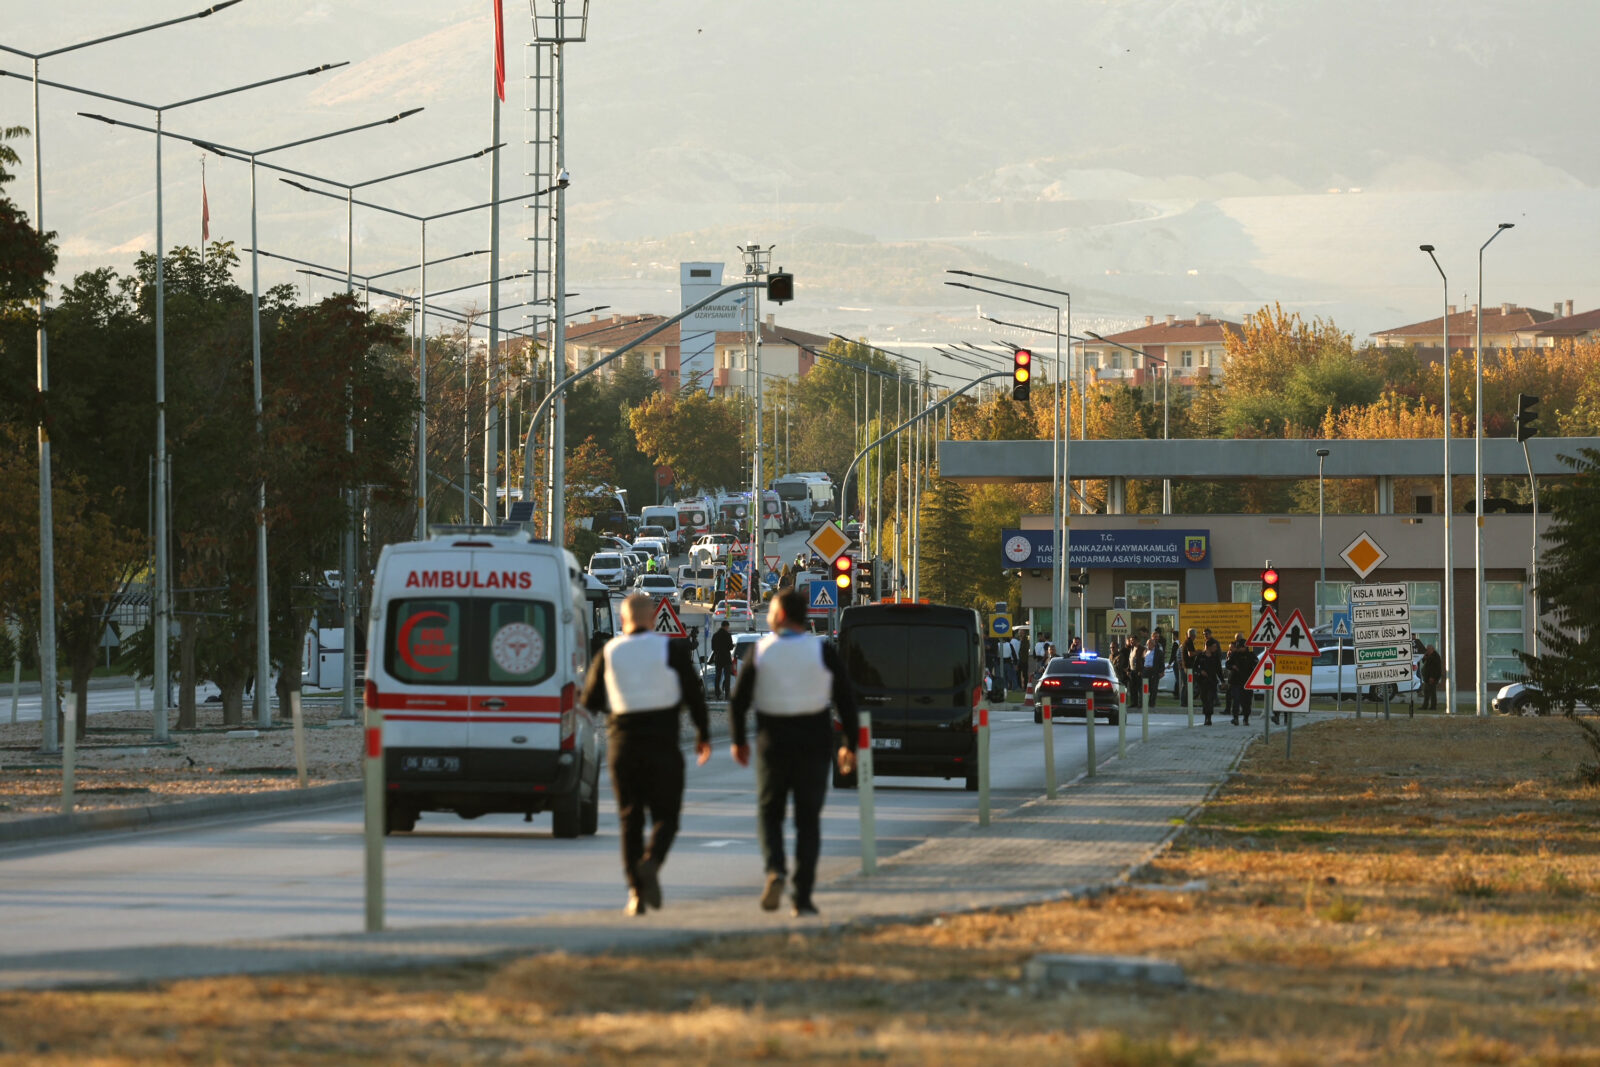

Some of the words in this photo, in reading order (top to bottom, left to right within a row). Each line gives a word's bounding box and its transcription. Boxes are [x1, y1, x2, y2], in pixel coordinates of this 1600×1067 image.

[1115, 543, 1178, 552] KAYMAKAMLIĞI
[1112, 554, 1141, 564] ASAYİŞ
[1143, 555, 1180, 563] NOKTASI
[405, 570, 532, 589] AMBULANS
[1353, 588, 1374, 599] KIŞLA
[1376, 588, 1394, 597] MAH.
[1381, 607, 1396, 617] MAH.
[1381, 626, 1397, 638] ÜSSÜ
[1359, 648, 1397, 660] Çevreyolu
[1384, 669, 1399, 679] KAZAN
[1283, 687, 1300, 699] 30
